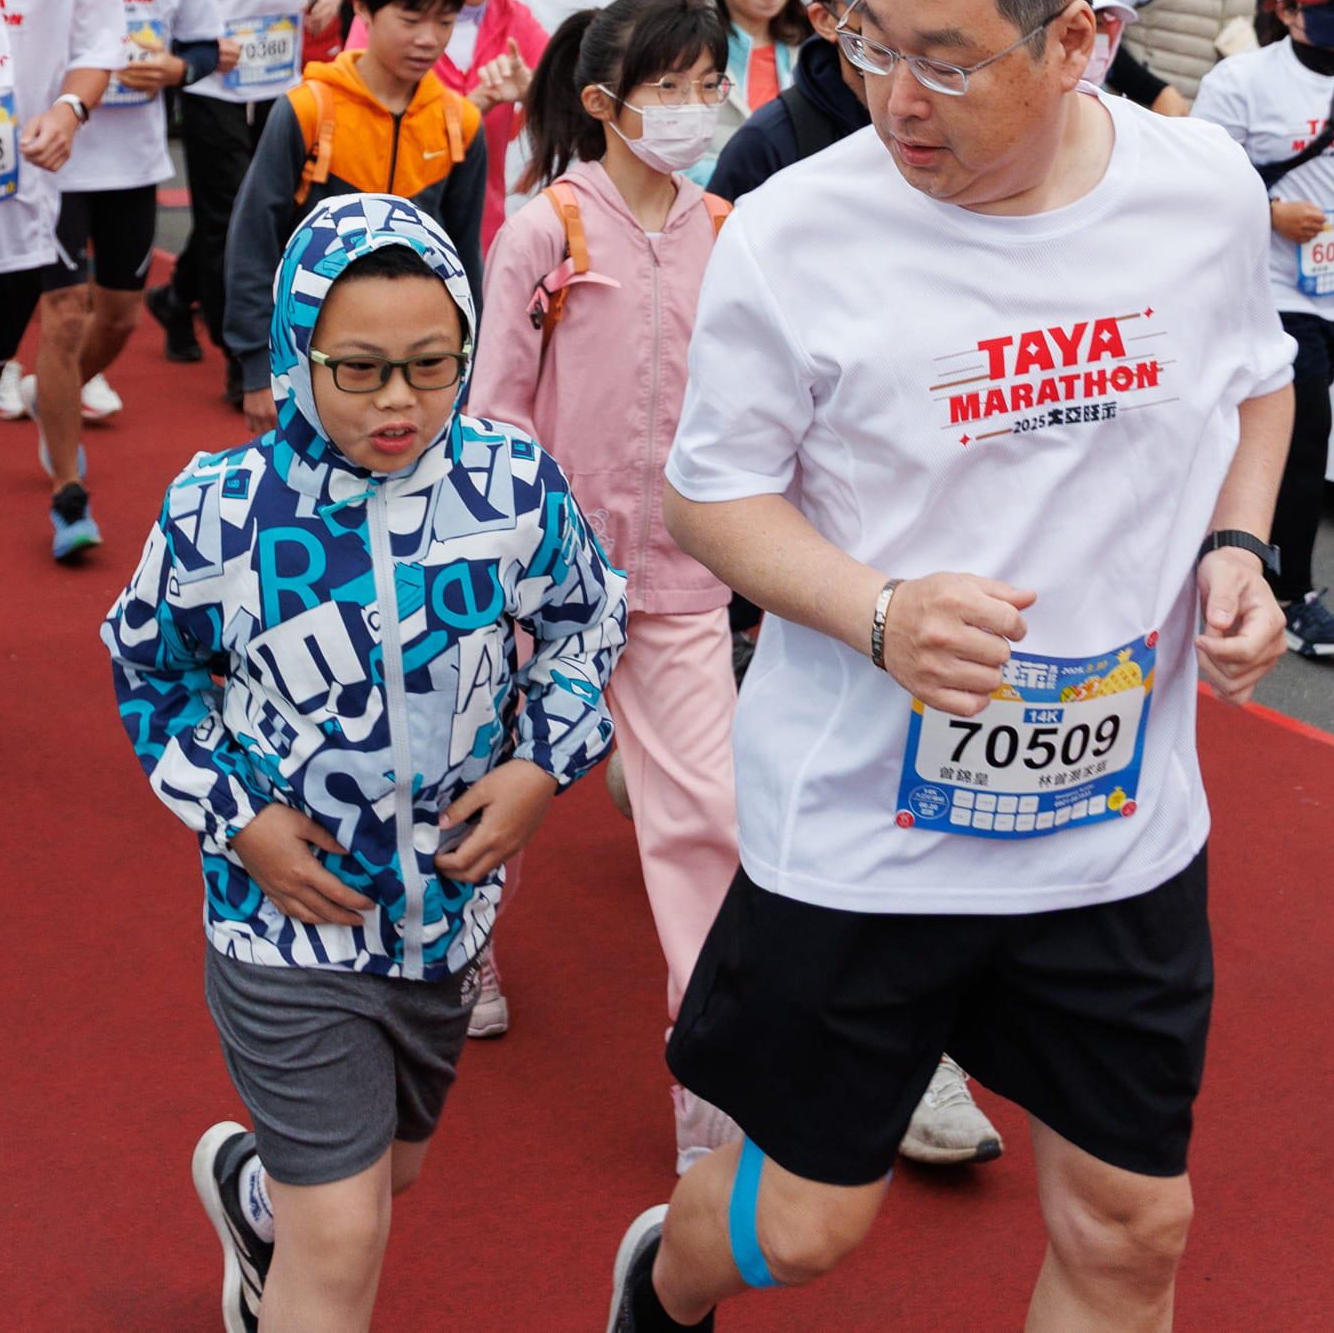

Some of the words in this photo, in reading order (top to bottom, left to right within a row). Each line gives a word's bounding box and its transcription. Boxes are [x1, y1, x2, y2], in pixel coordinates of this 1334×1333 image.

[978, 317, 1126, 381] TAYA
[949, 360, 1159, 424] MARATHON
[1013, 415, 1047, 434] 2025
[948, 714, 1121, 770] 70509
[1029, 709, 1059, 723] 14K
